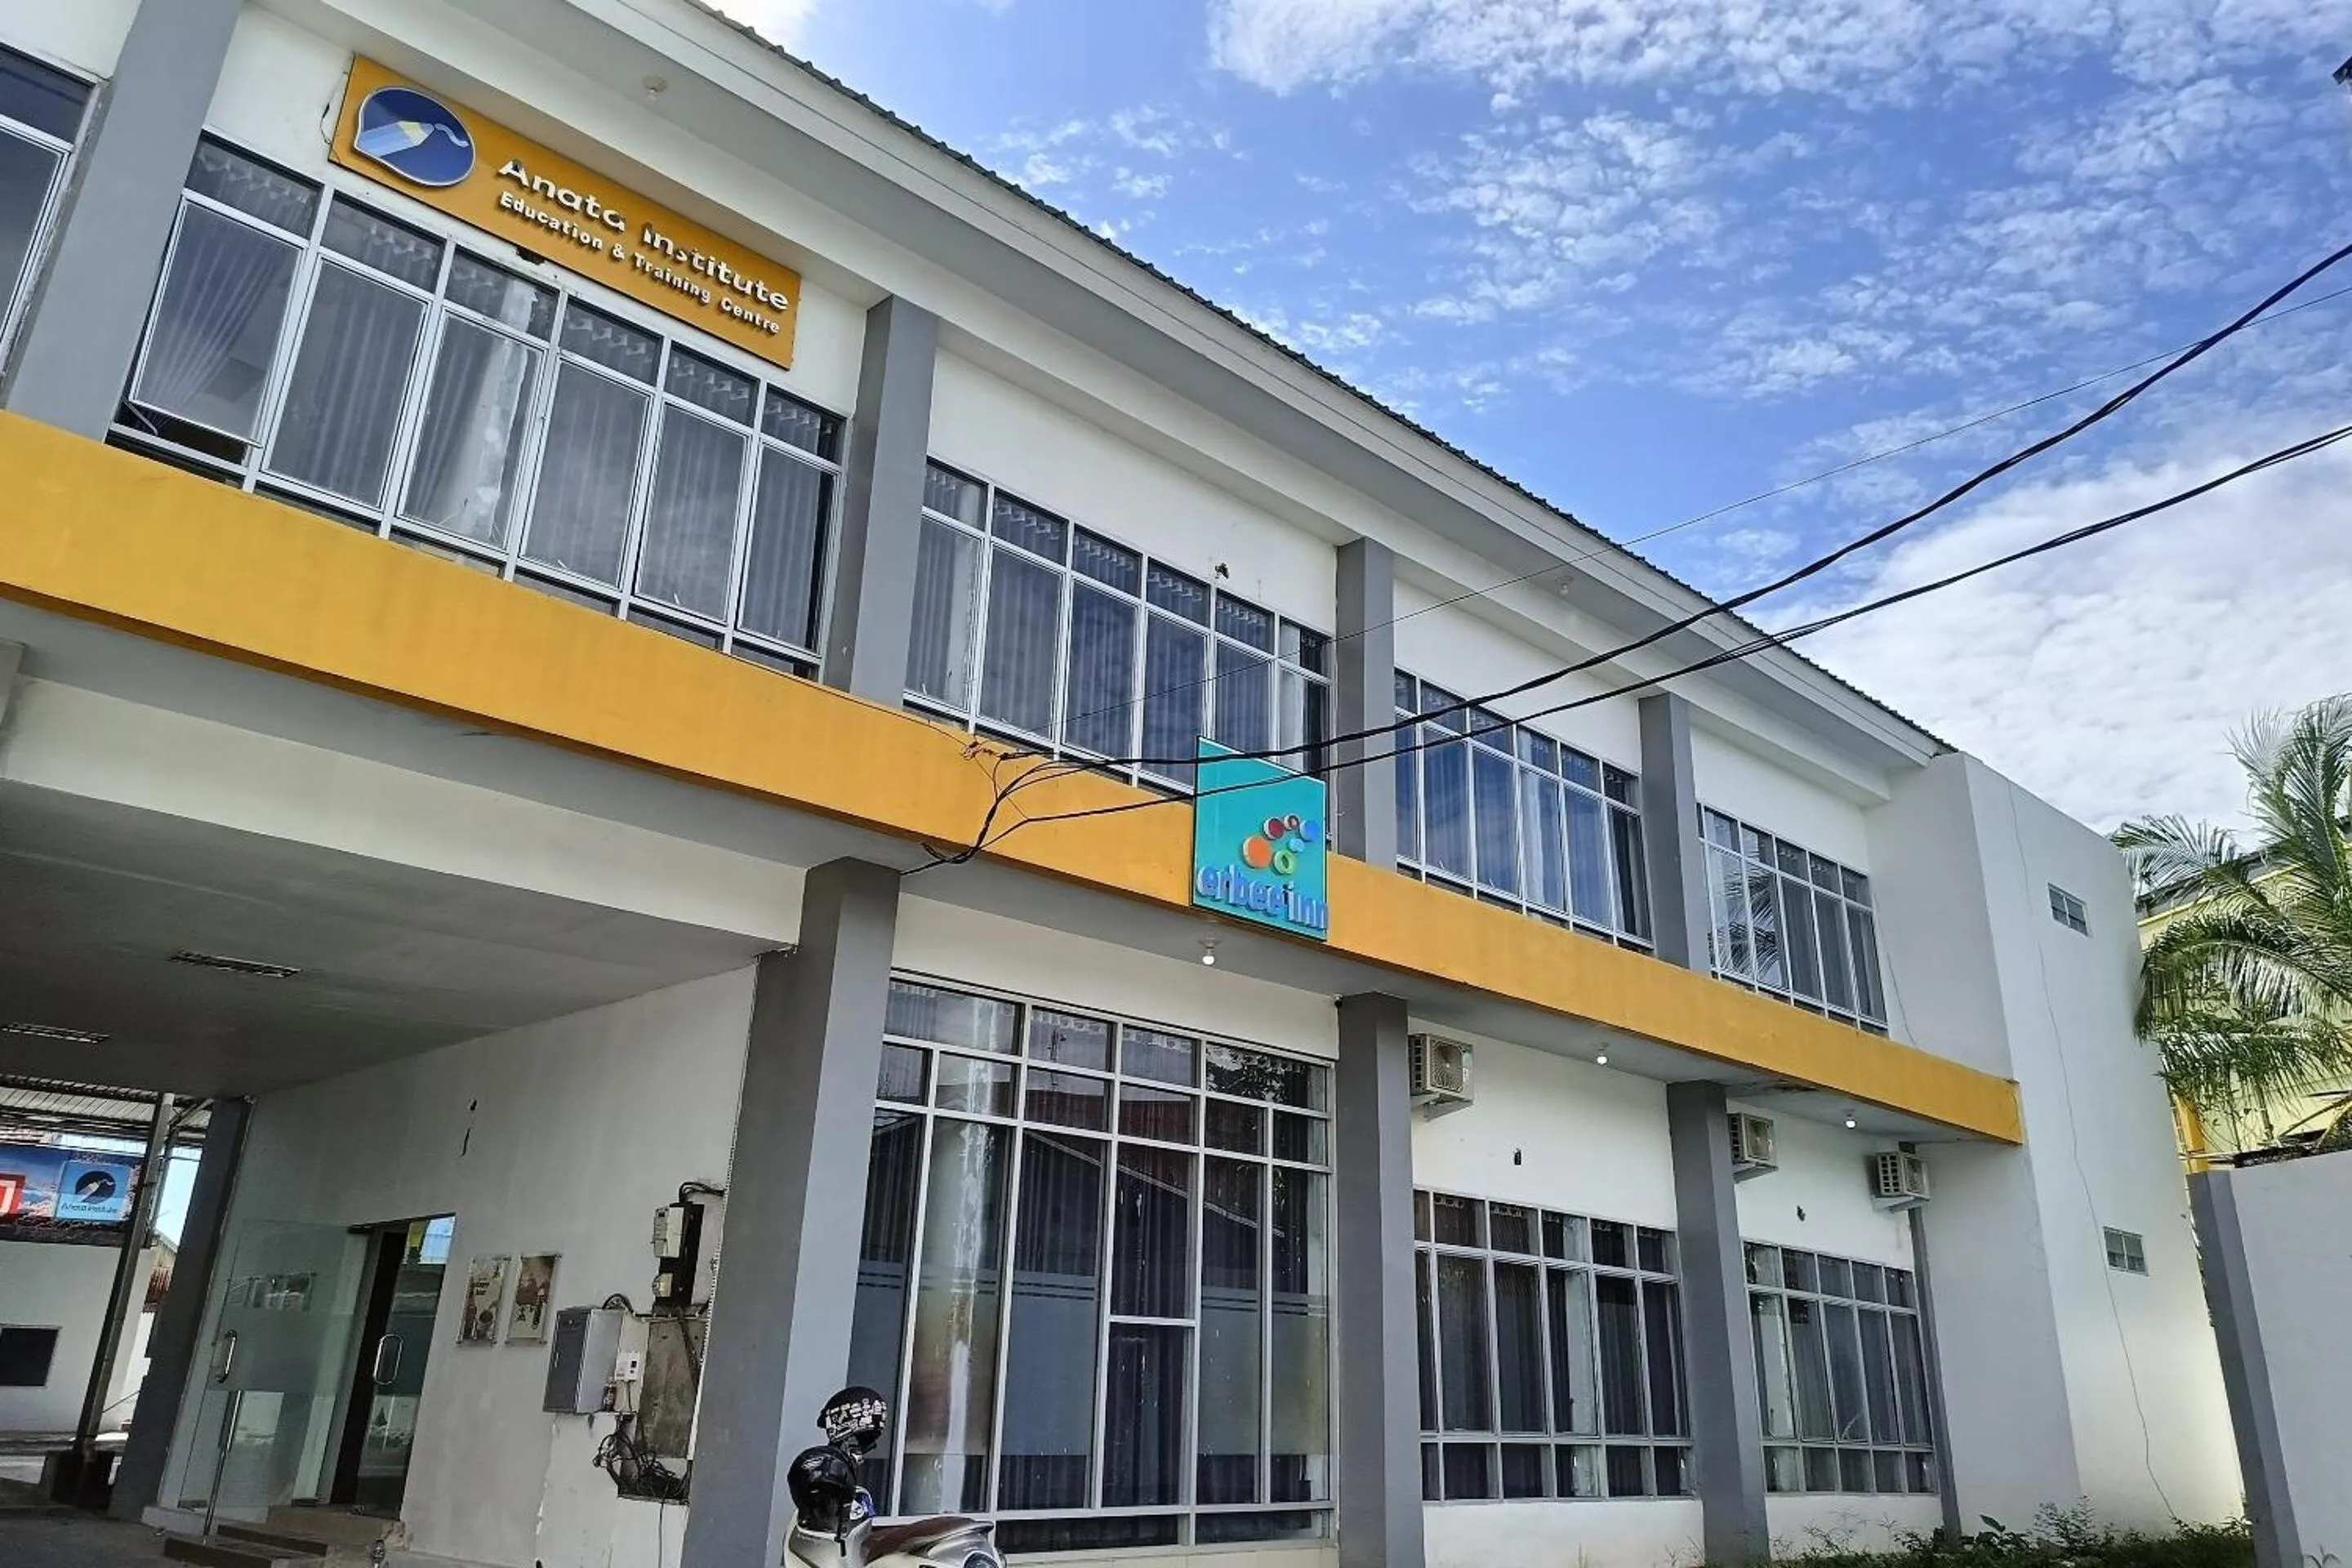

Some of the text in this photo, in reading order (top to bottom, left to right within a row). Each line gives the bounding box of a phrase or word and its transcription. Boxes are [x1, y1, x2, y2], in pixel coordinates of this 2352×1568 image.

[499, 160, 626, 232] Anata
[500, 190, 780, 333] Education & Training Centre
